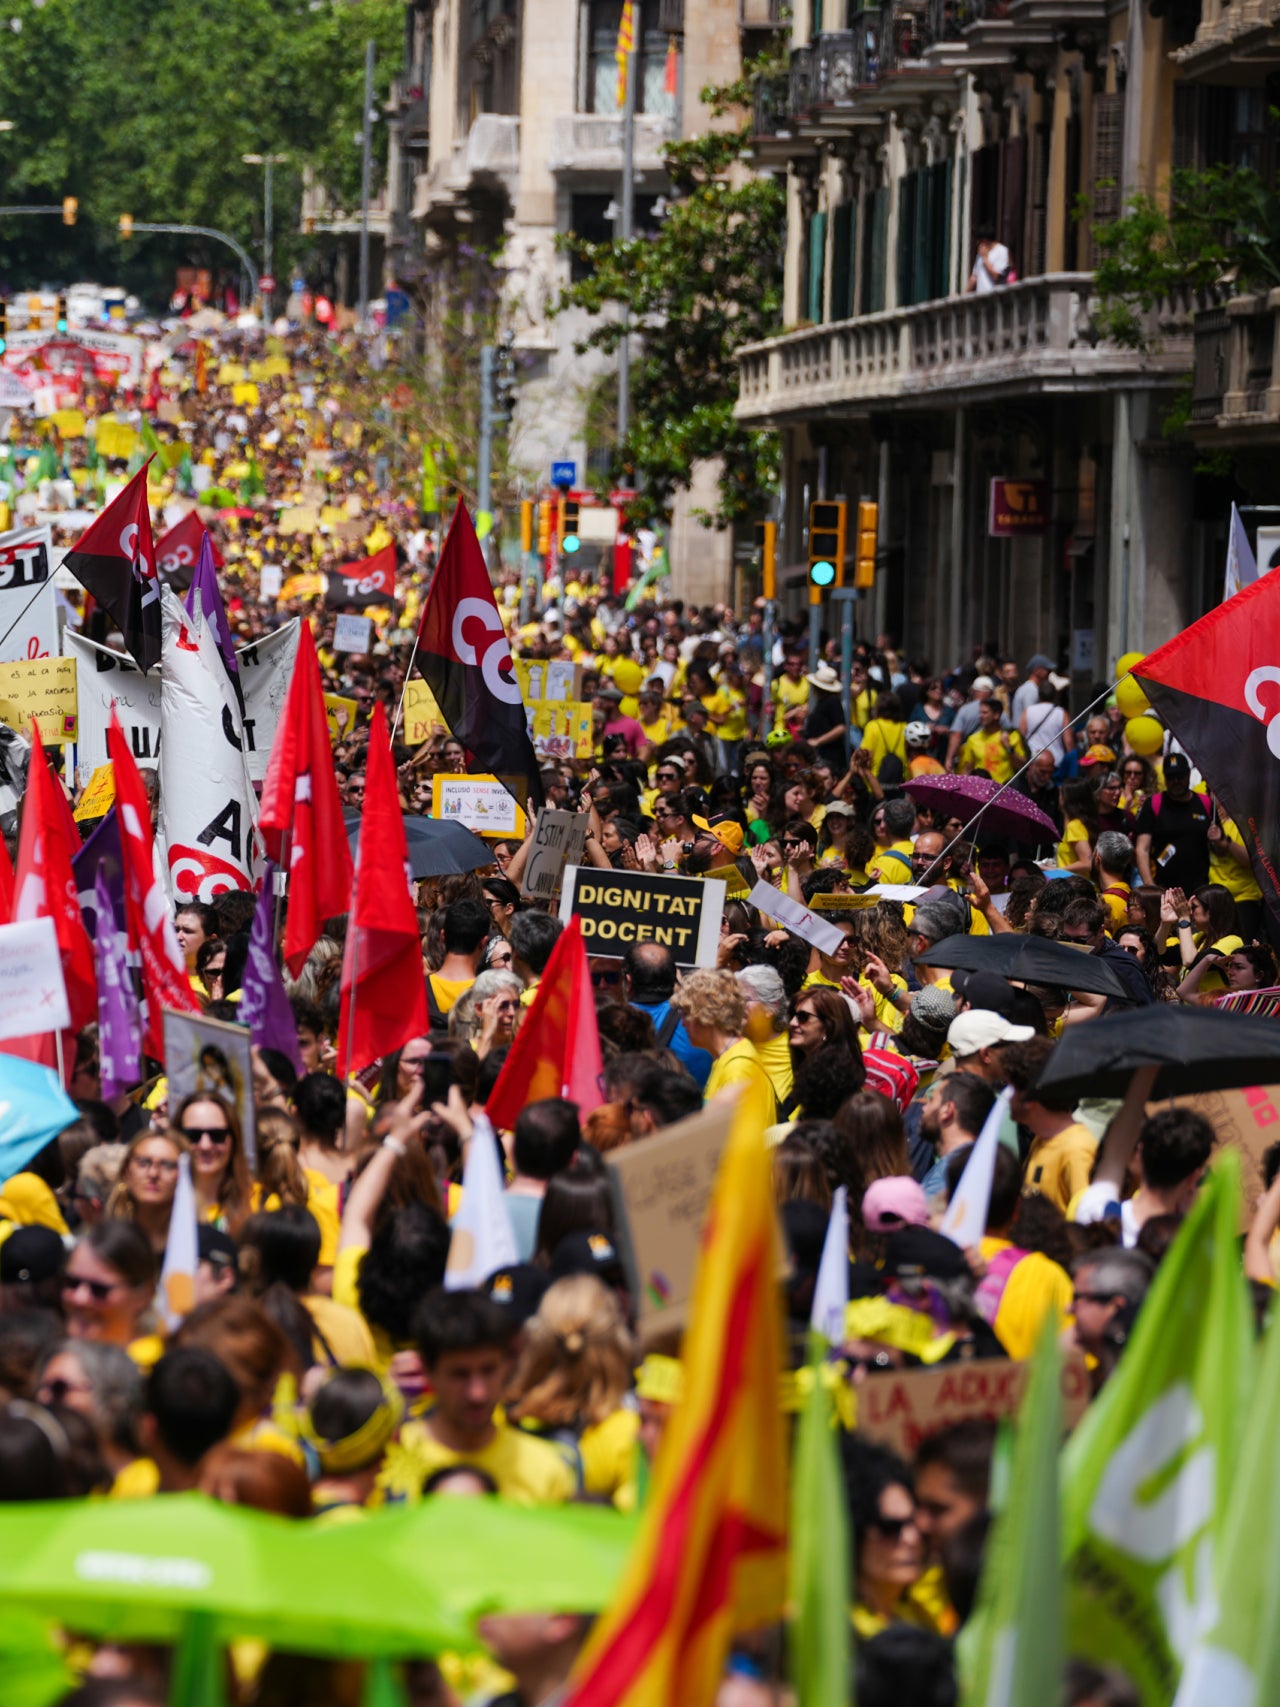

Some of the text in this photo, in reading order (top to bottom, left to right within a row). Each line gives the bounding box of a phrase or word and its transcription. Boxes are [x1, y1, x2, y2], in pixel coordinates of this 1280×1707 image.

[445, 785, 470, 794] INCLUSIÓ
[578, 884, 701, 916] DIGNITAT
[580, 917, 693, 947] DOCENT
[867, 1381, 913, 1424] LA
